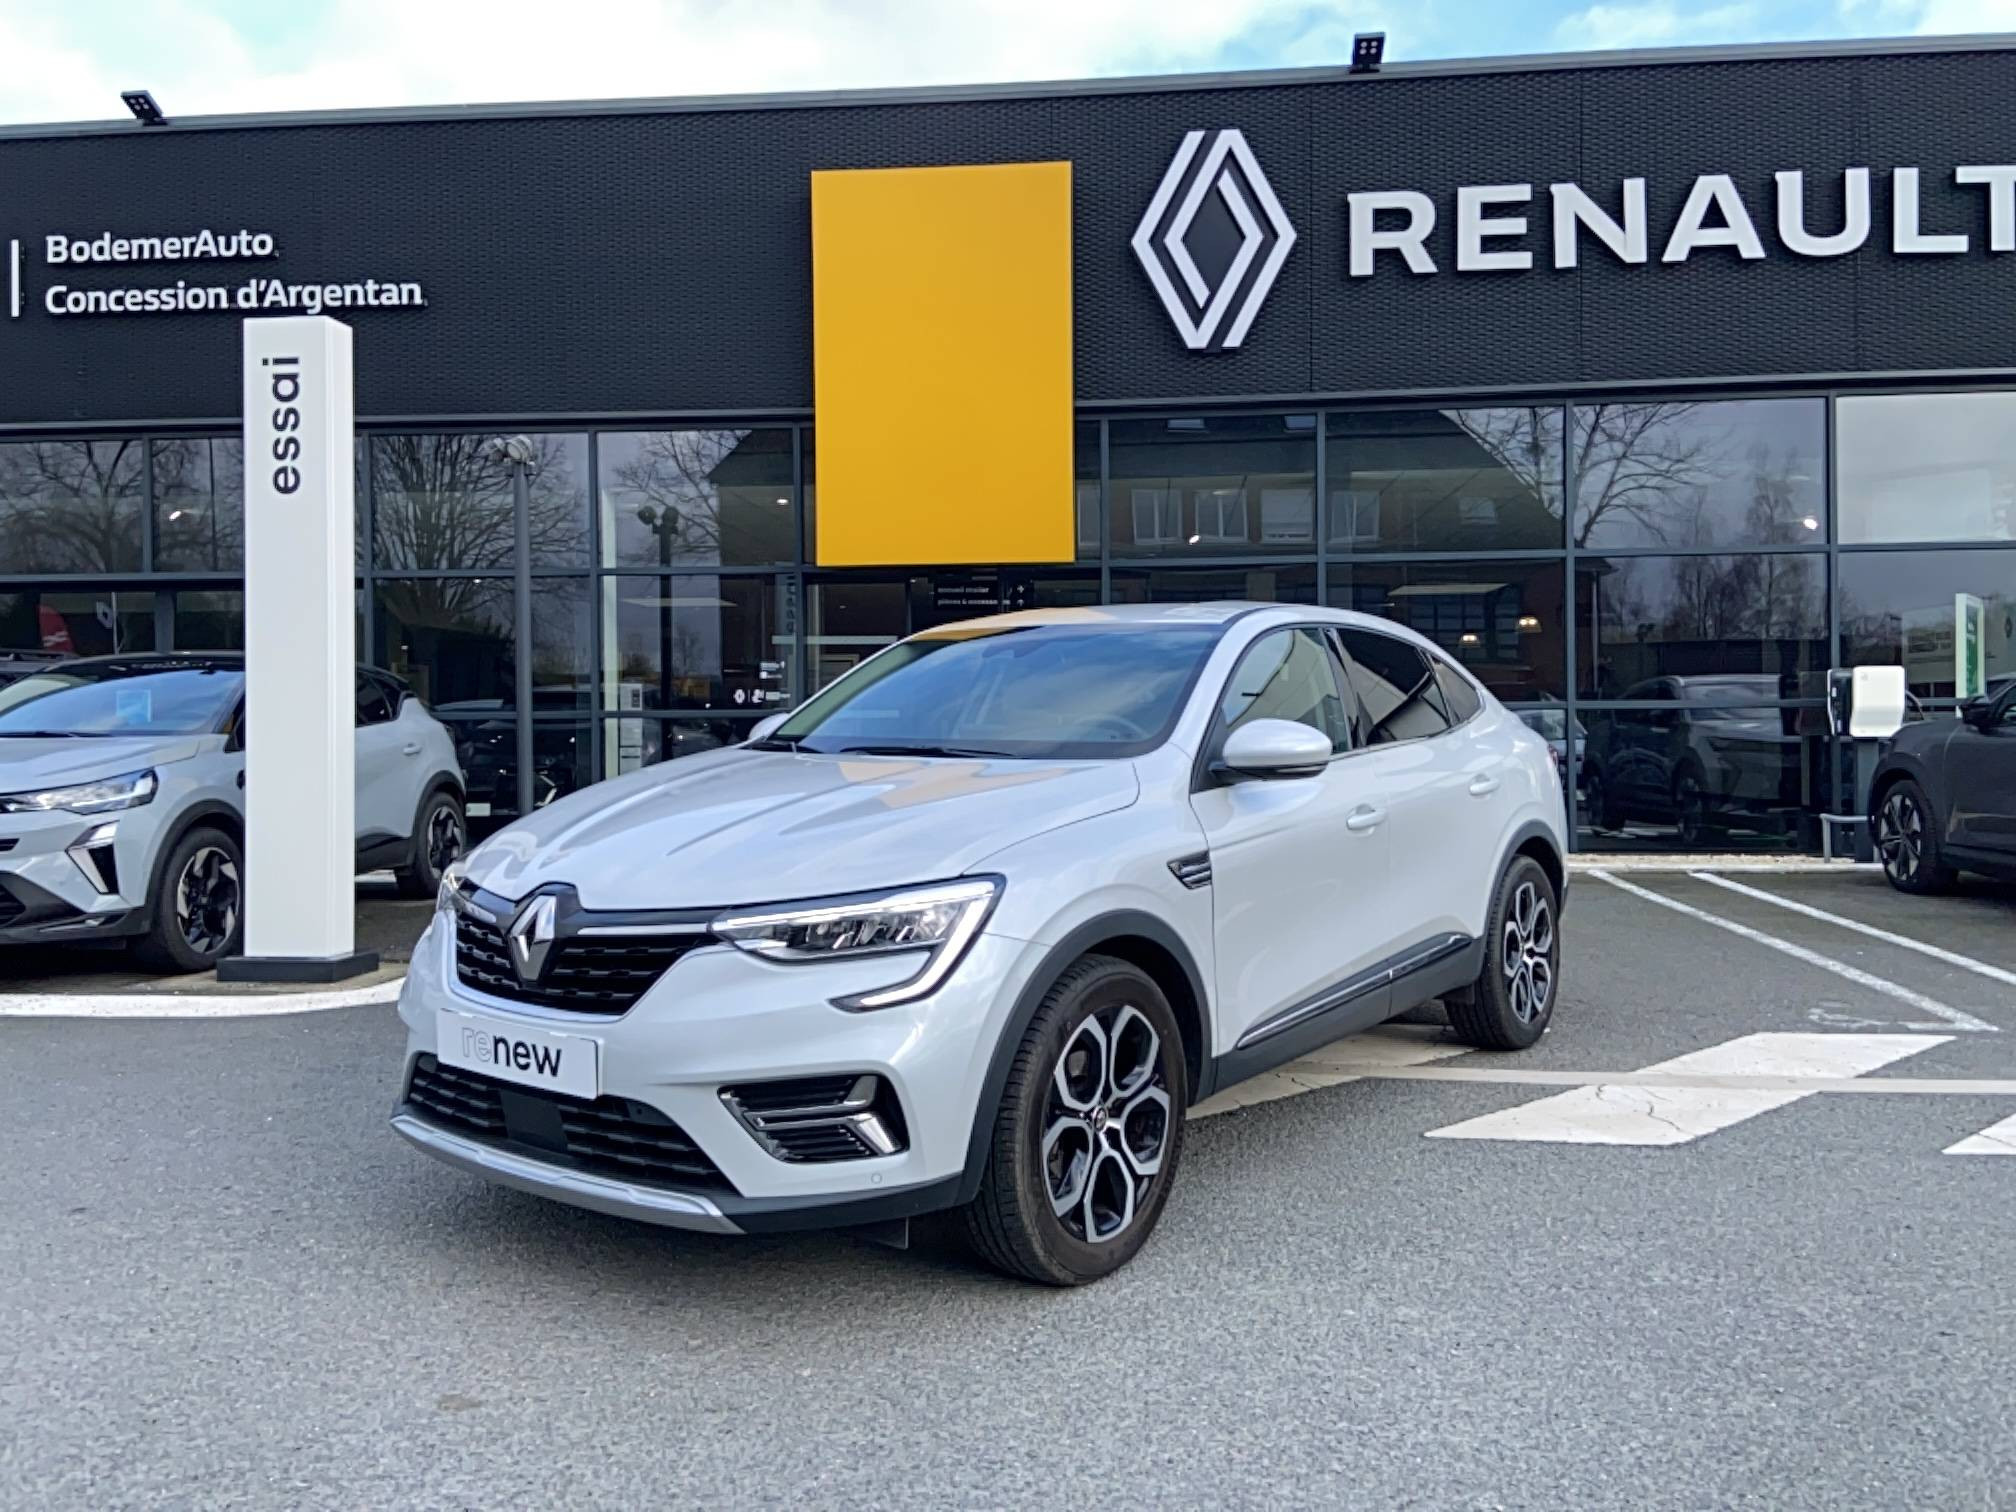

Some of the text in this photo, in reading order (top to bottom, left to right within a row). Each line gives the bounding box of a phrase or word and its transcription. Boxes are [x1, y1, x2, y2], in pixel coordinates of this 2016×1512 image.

[1347, 165, 2016, 277] RENAULT
[46, 230, 274, 263] BodemerAuto
[46, 279, 424, 315] Concession d'Argentan
[262, 357, 301, 495] essai
[461, 1027, 562, 1077] renew
